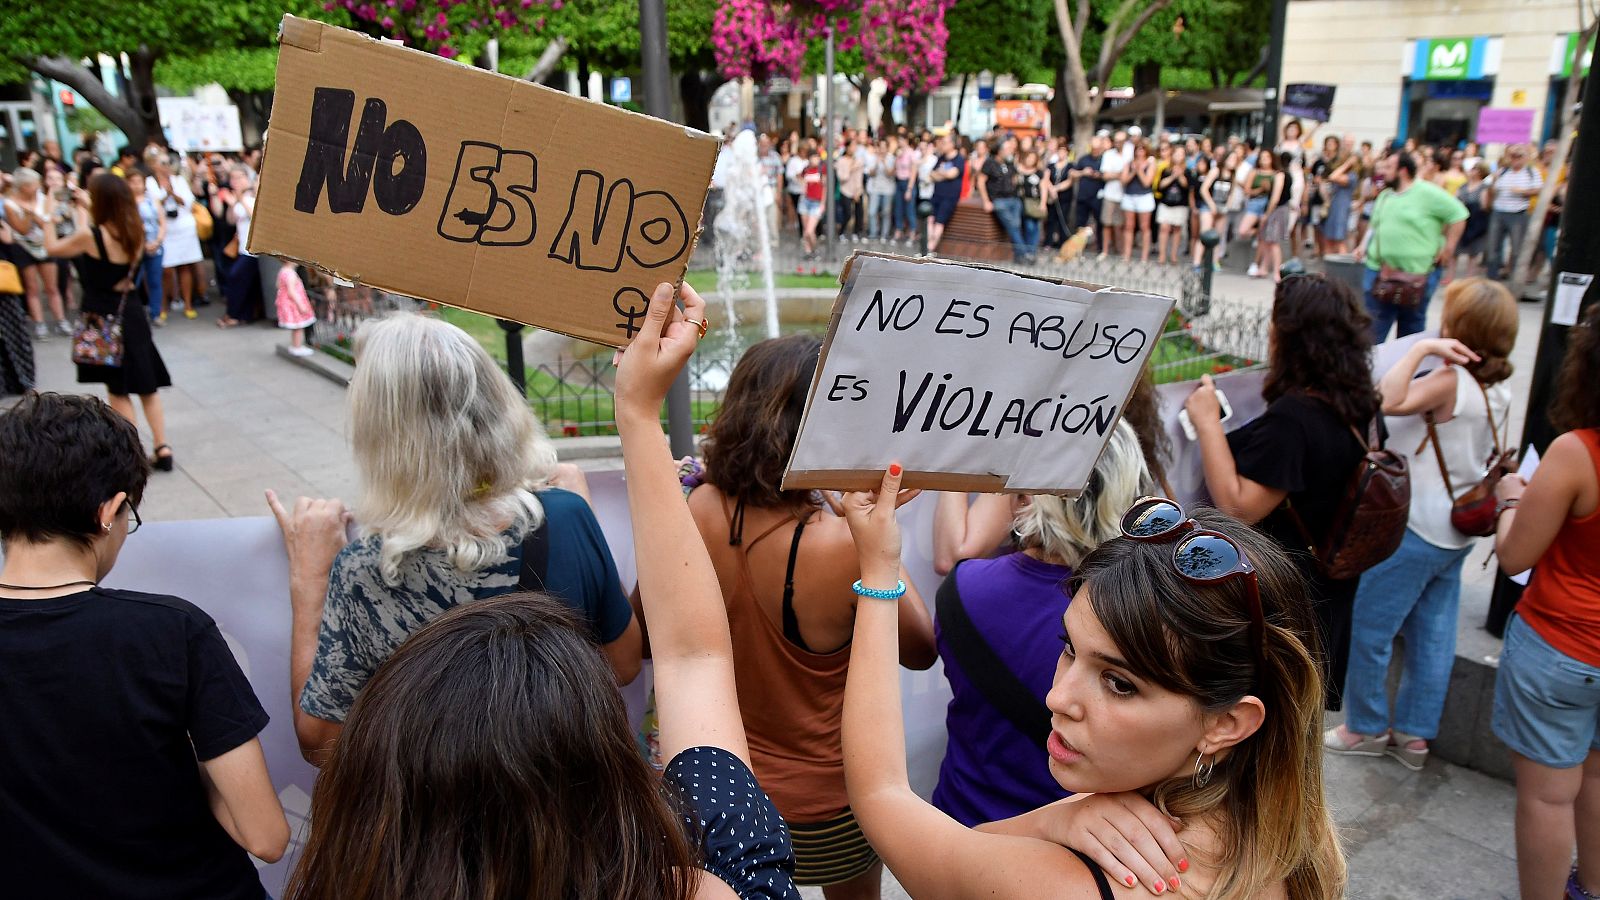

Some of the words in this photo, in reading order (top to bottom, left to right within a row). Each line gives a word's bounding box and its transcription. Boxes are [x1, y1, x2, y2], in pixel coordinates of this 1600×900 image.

[294, 87, 427, 215] NO
[437, 141, 538, 246] ES
[547, 169, 690, 272] NO
[856, 289, 925, 332] NO
[935, 298, 995, 338] ES
[1009, 311, 1147, 364] ABUSO
[827, 374, 870, 402] ES
